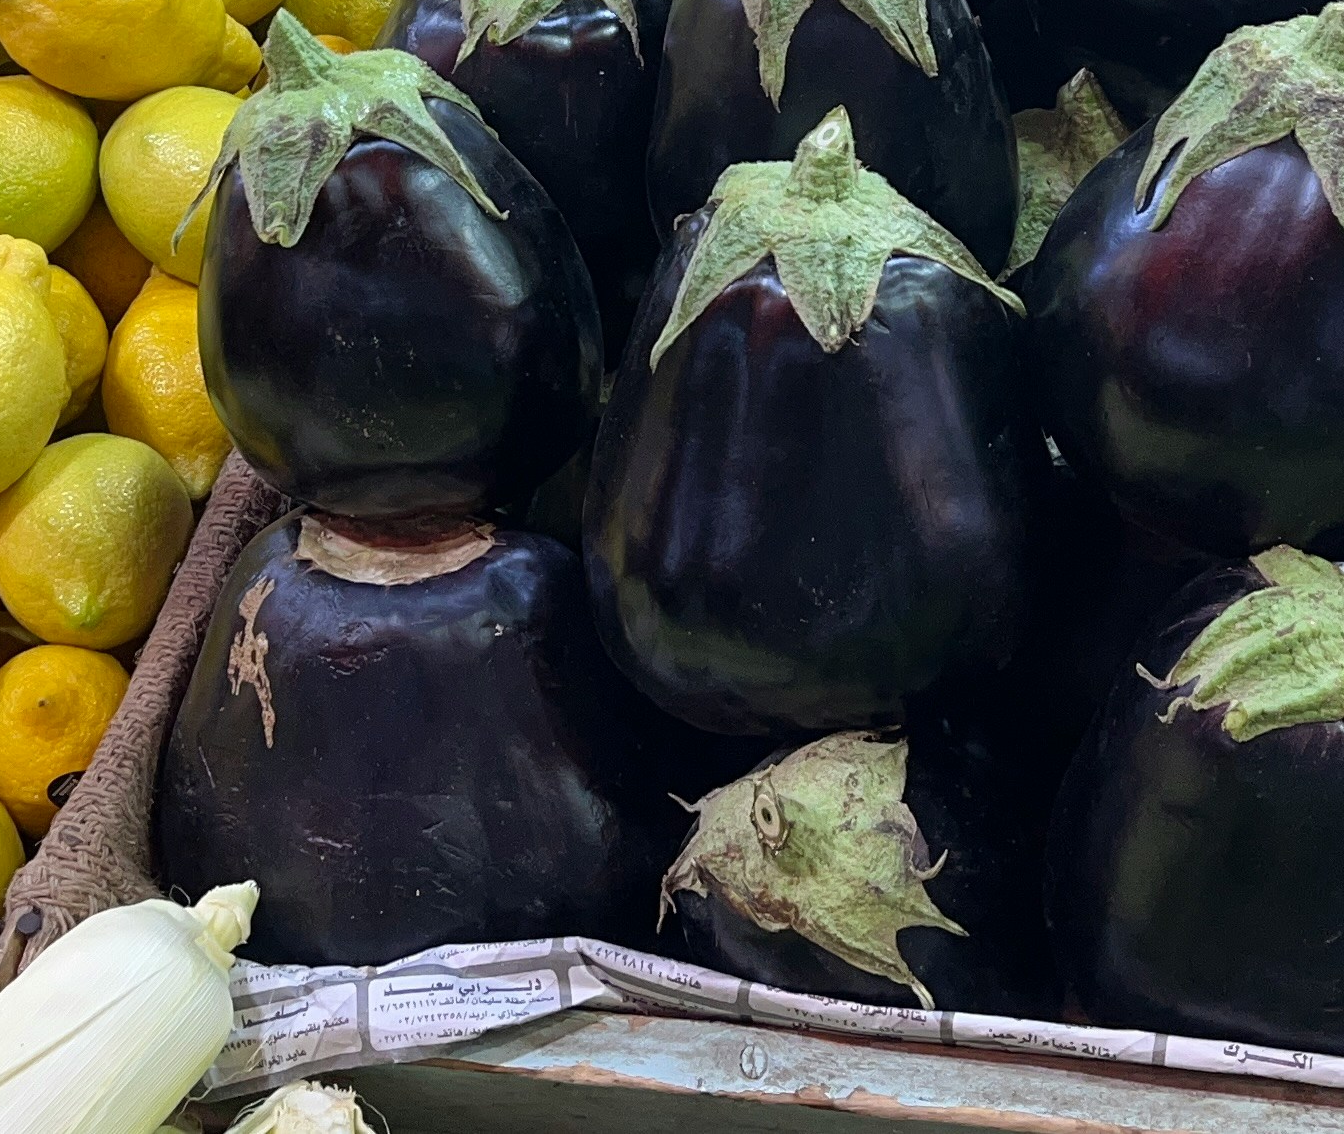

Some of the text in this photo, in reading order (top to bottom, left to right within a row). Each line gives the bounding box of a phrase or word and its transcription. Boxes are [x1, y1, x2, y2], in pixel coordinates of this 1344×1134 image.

[383, 978, 542, 997] دير ابي سعيد
[666, 971, 702, 990] هاتف
[528, 995, 555, 1004] محمد
[323, 1016, 349, 1032] مكتبة
[1042, 1037, 1077, 1053] ضياء
[1223, 1043, 1313, 1070] الكرك
